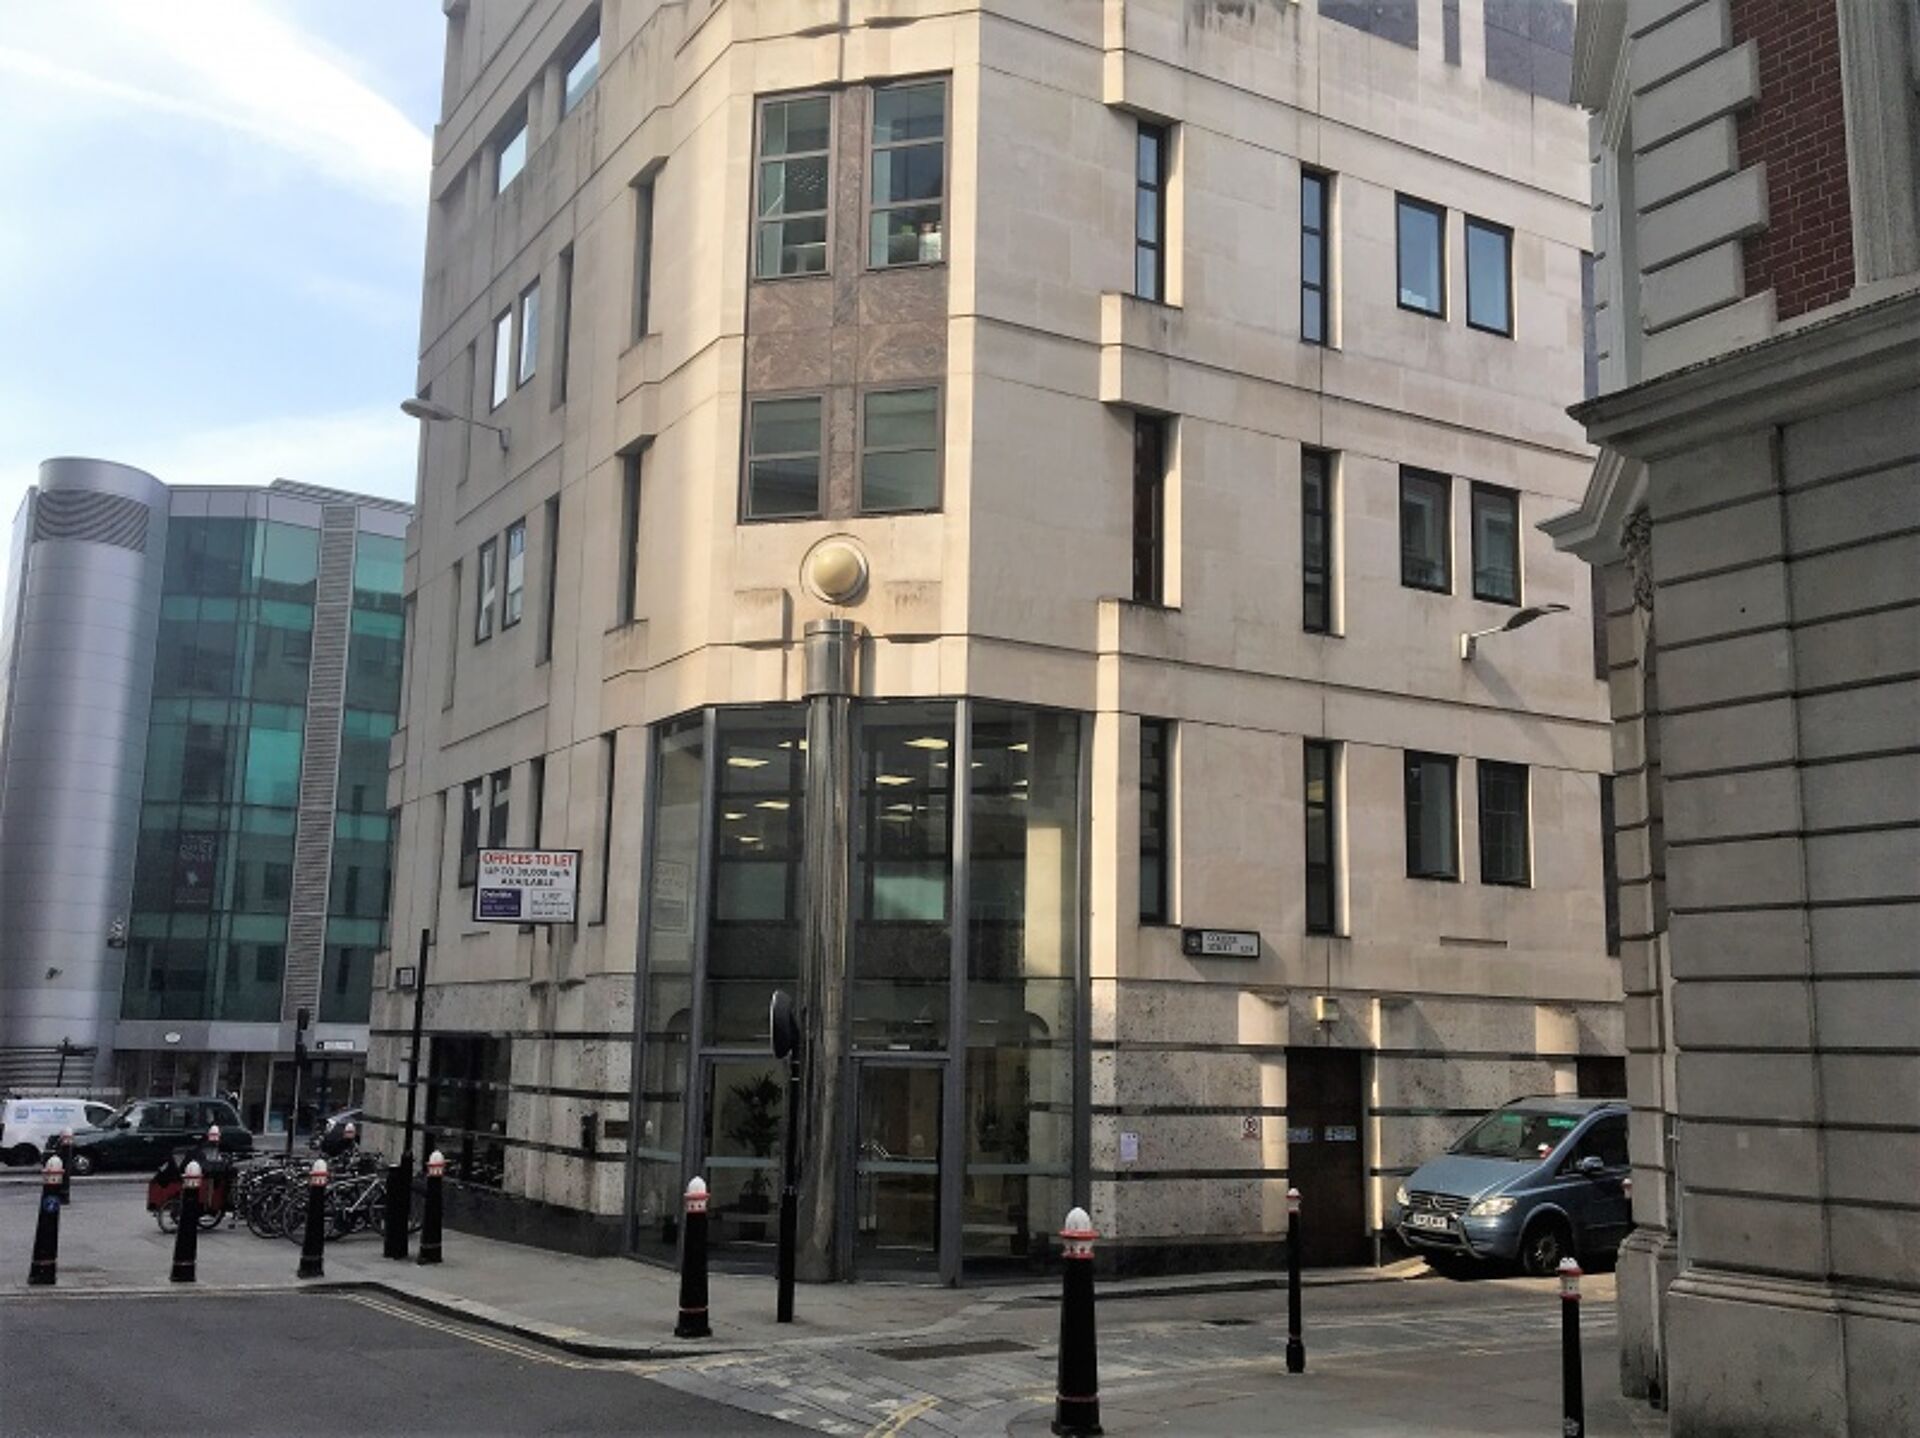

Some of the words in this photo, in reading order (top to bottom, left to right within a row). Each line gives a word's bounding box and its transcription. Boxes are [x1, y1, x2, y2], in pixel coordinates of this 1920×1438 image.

[483, 852, 532, 865] OFFICES
[535, 854, 550, 865] TO
[554, 854, 574, 867] LET
[501, 866, 515, 876] TO
[501, 878, 554, 886] AVAILABLE
